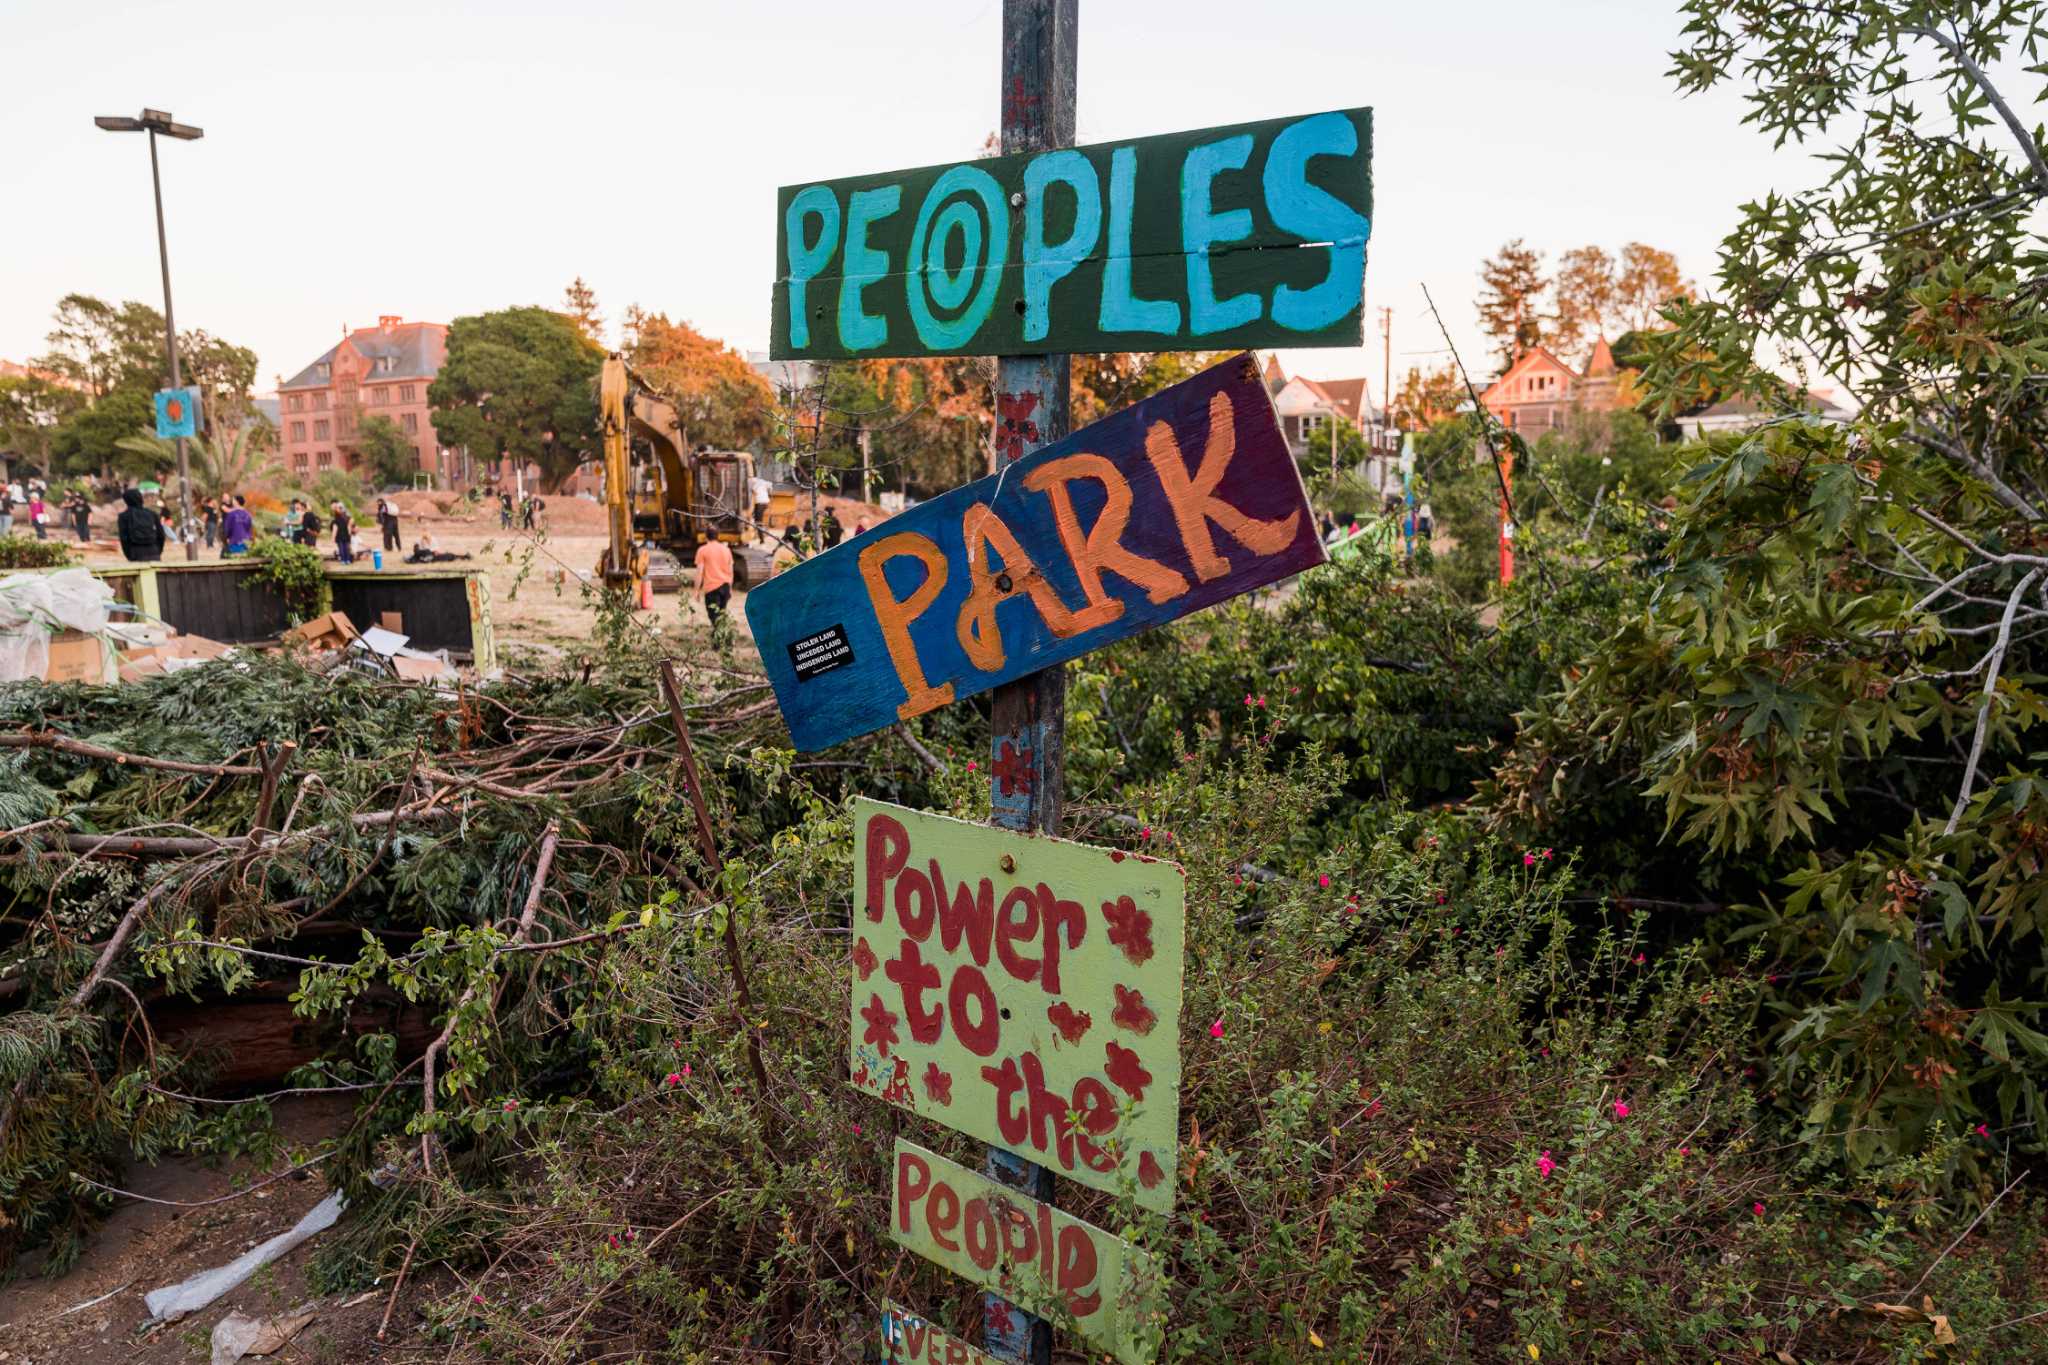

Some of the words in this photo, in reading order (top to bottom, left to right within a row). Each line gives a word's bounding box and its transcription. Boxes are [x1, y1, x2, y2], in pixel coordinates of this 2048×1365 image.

[785, 111, 1370, 351] PEOPLES
[858, 390, 1301, 721] PARK
[796, 637, 819, 651] STOLEN
[819, 630, 836, 641] LAND
[796, 645, 825, 661] UNCEDED
[825, 638, 842, 650] LAND
[796, 652, 832, 671] INDIGENOUS
[832, 645, 850, 657] LAND
[866, 813, 1087, 994] Power
[884, 939, 1000, 1058] to
[980, 1051, 1124, 1172] the
